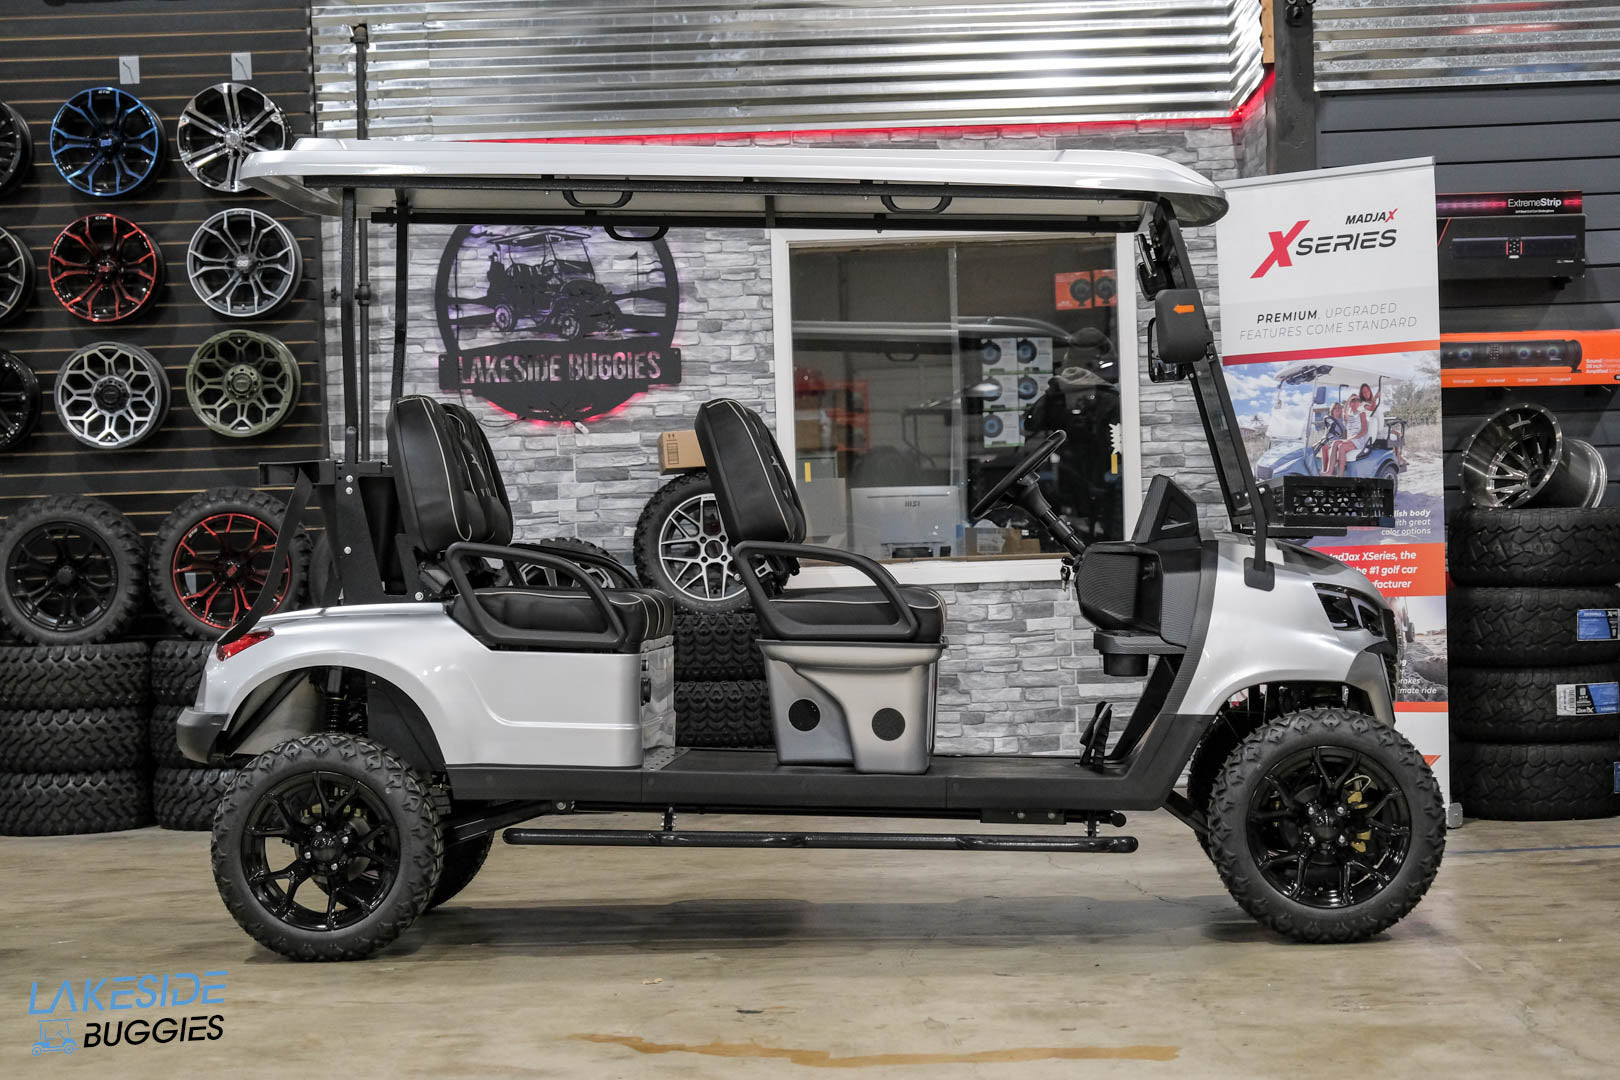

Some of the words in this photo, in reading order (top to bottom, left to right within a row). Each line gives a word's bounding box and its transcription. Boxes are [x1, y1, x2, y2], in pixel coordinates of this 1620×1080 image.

[1507, 197, 1562, 208] ExtremeStrip
[1345, 208, 1398, 225] MADJAX
[1325, 302, 1397, 318] UPGRADED
[1239, 325, 1303, 341] FEATURES
[1306, 322, 1343, 337] COME
[1347, 315, 1418, 332] STANDARD
[457, 352, 563, 384] LAKESIDE
[568, 351, 662, 384] BUGGIES
[1394, 509, 1408, 518] lish
[1409, 509, 1431, 518] body
[1408, 518, 1431, 527] great
[1381, 528, 1401, 536] color
[1401, 527, 1431, 537] options
[1329, 552, 1360, 562] adJax
[1361, 551, 1398, 561] XSeries,
[1400, 550, 1416, 560] the
[1369, 566, 1379, 575] #1
[1380, 565, 1400, 576] golf
[1401, 566, 1418, 574] car
[1372, 579, 1412, 589] facturer
[1399, 677, 1421, 685] rakes
[1398, 686, 1420, 694] imate
[1421, 686, 1437, 694] ride
